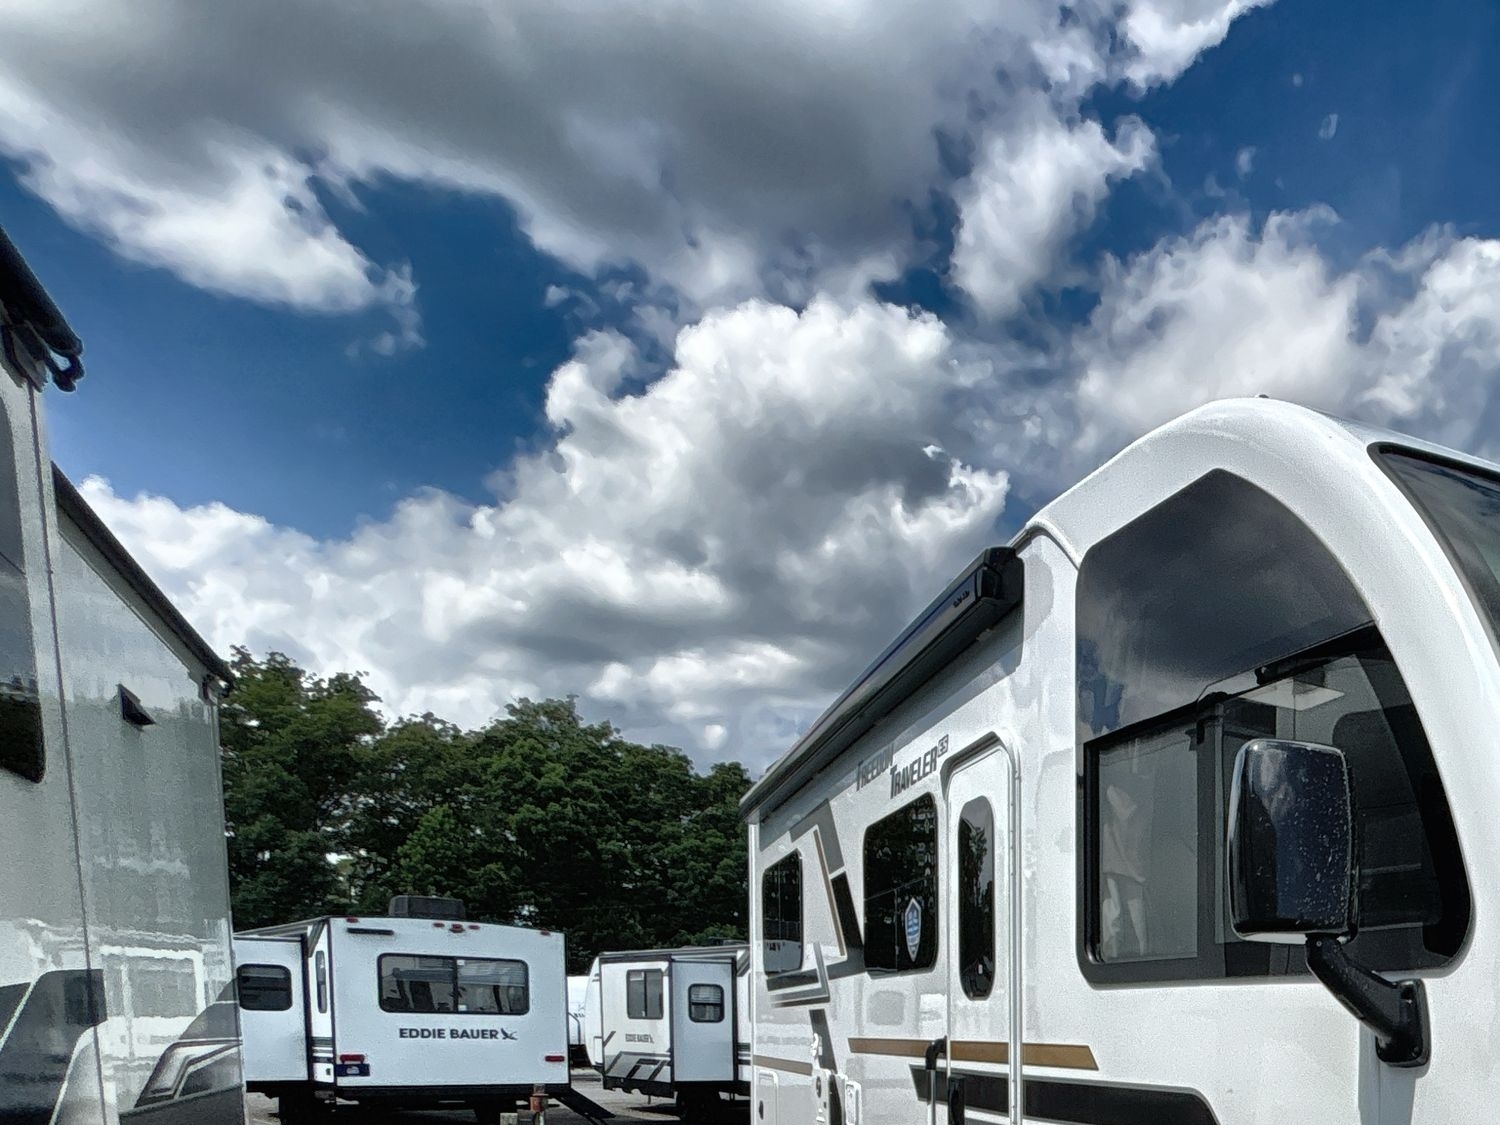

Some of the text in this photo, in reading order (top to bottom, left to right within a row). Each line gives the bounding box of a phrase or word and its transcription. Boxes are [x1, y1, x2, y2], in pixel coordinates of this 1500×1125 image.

[890, 745, 938, 799] TRAVELER
[399, 1027, 499, 1040] EDDIE BAUER
